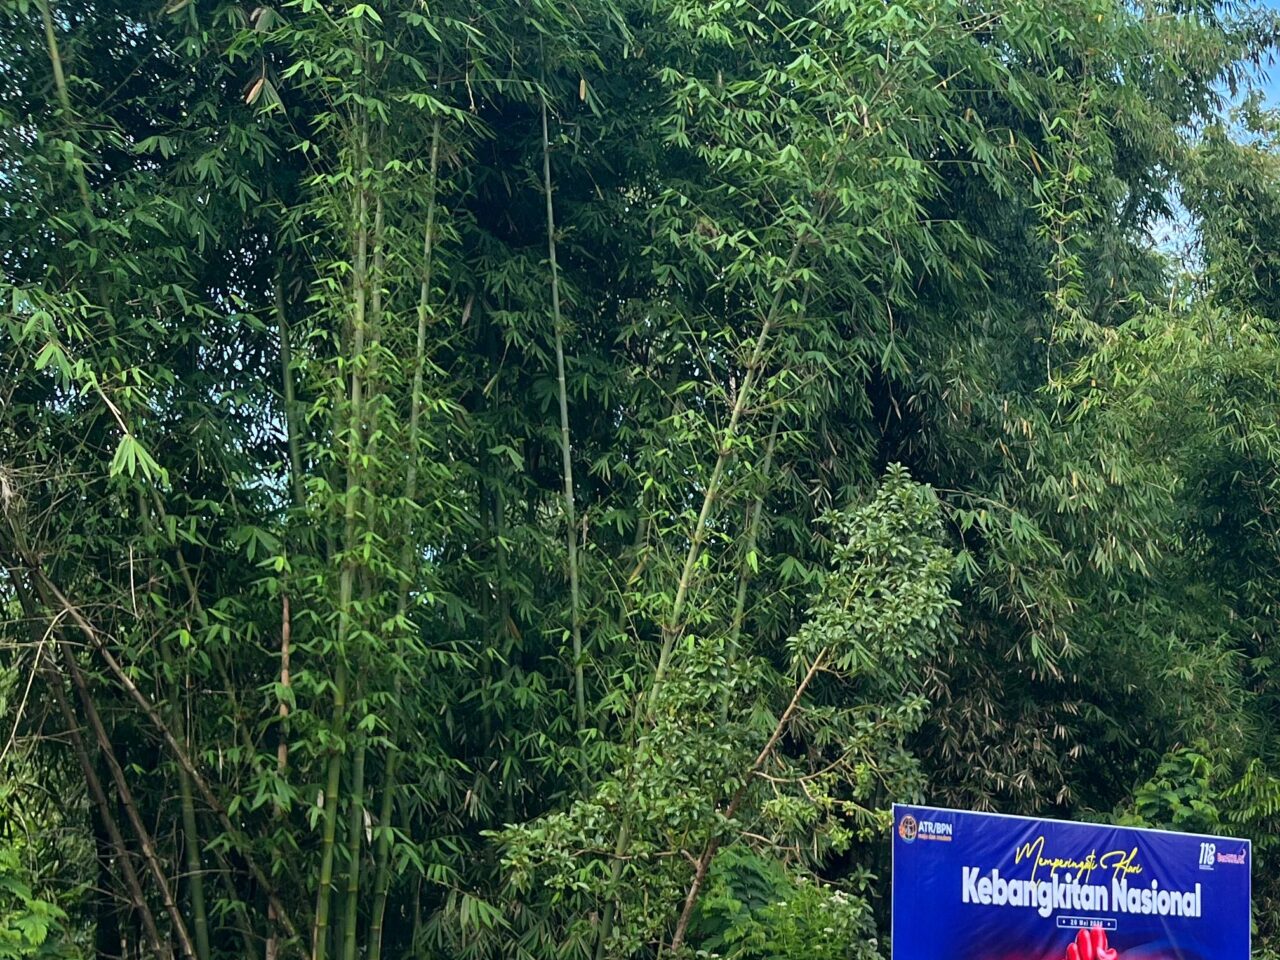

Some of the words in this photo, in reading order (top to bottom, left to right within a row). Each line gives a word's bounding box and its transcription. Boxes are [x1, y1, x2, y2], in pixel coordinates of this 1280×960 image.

[918, 820, 953, 835] ATR/BPN
[1015, 836, 1098, 886] Memperingati
[1100, 847, 1142, 882] Hari
[962, 866, 1109, 918] Kebangkitan
[1111, 877, 1202, 918] Nasional
